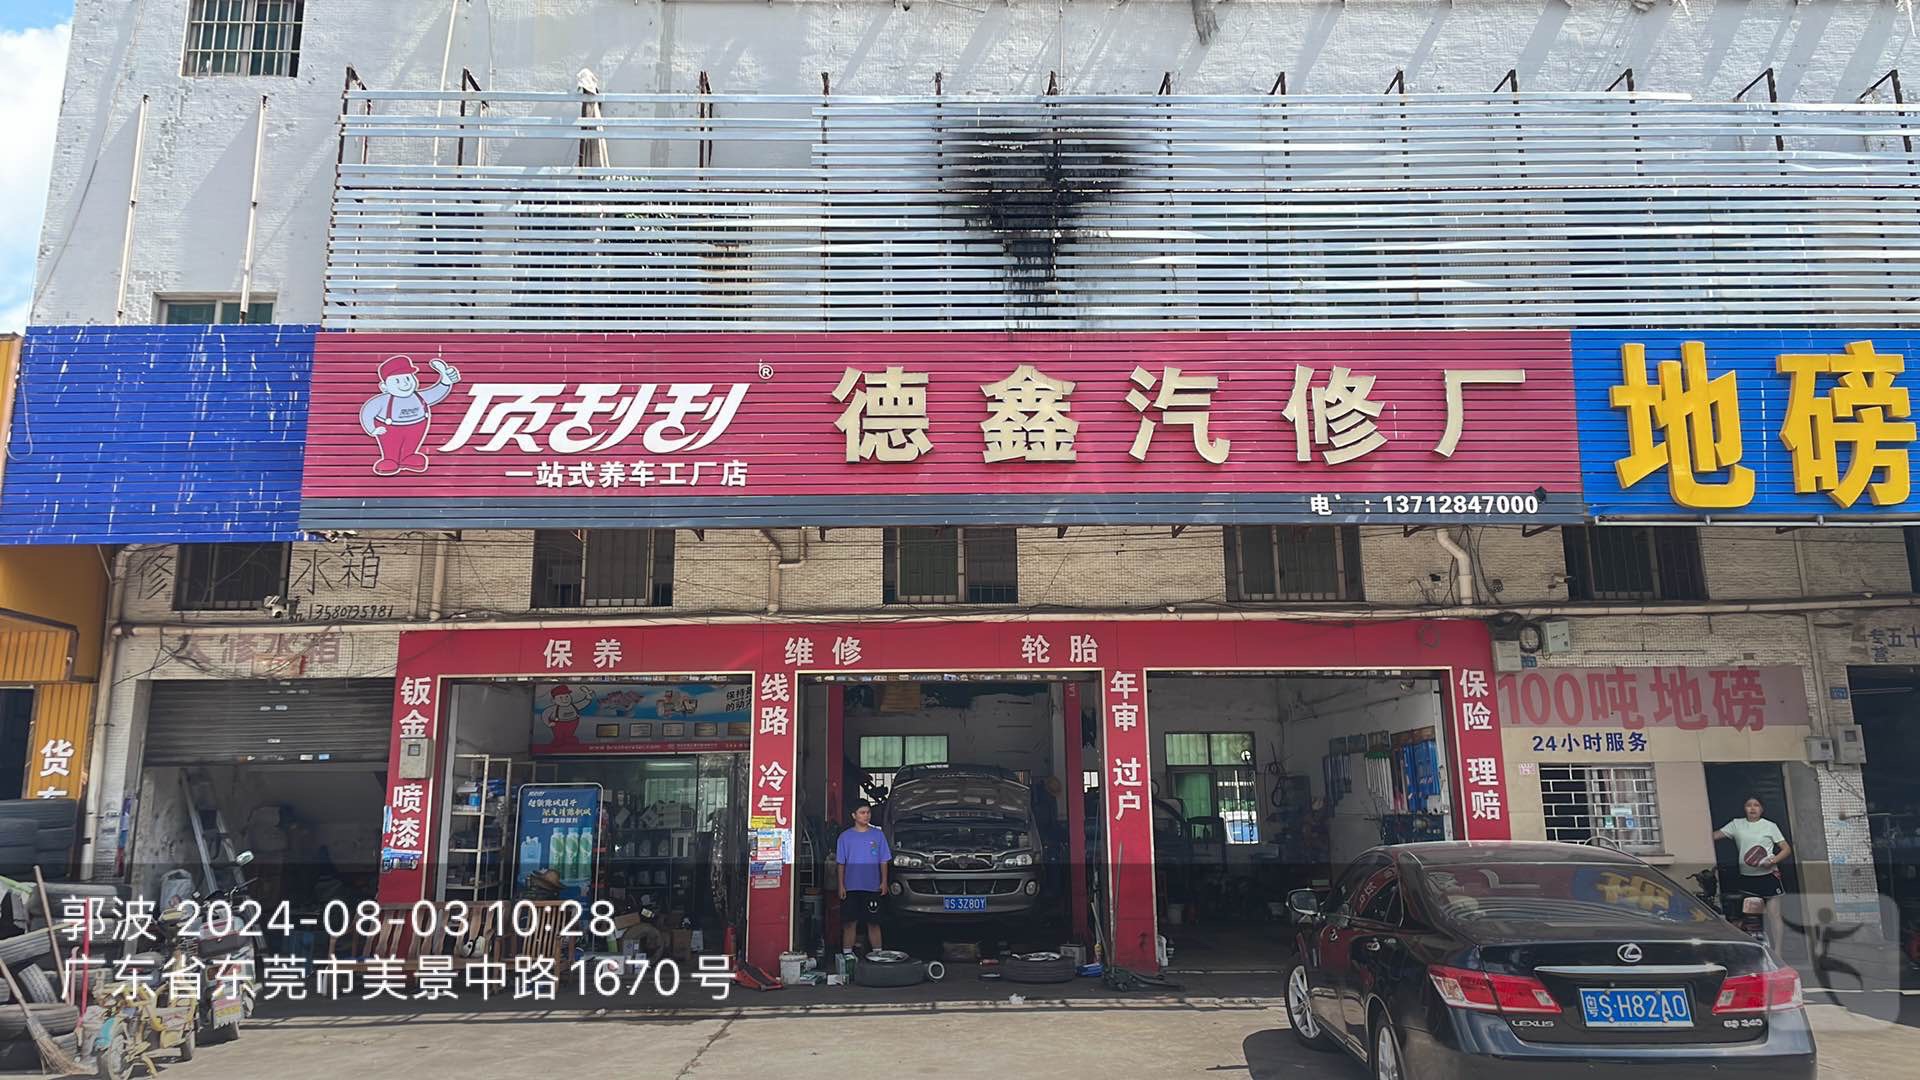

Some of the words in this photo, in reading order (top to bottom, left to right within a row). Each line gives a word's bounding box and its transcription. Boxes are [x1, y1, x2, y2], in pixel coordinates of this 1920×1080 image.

[832, 364, 1526, 466] 德鑫汽修厂
[1609, 339, 1917, 508] 地磅
[505, 461, 748, 487] 一站式养车工厂店
[292, 541, 385, 595] 水箱
[309, 604, 393, 621] 13580735981
[544, 638, 623, 669] 保养
[784, 636, 863, 666] 维修
[1021, 634, 1098, 664] 轮胎
[400, 676, 432, 738] 钣金
[759, 674, 791, 736] 线路
[1111, 671, 1139, 732] 年审
[1459, 669, 1493, 731] 保险
[1498, 666, 1767, 732] 100吨地磅
[1532, 732, 1647, 752] 24小时服务
[388, 784, 423, 849] 喷漆
[758, 761, 789, 826] 冷气
[1114, 758, 1142, 821] 过户
[1466, 757, 1502, 820] 理赔
[1512, 1020, 1554, 1028] LEXUS
